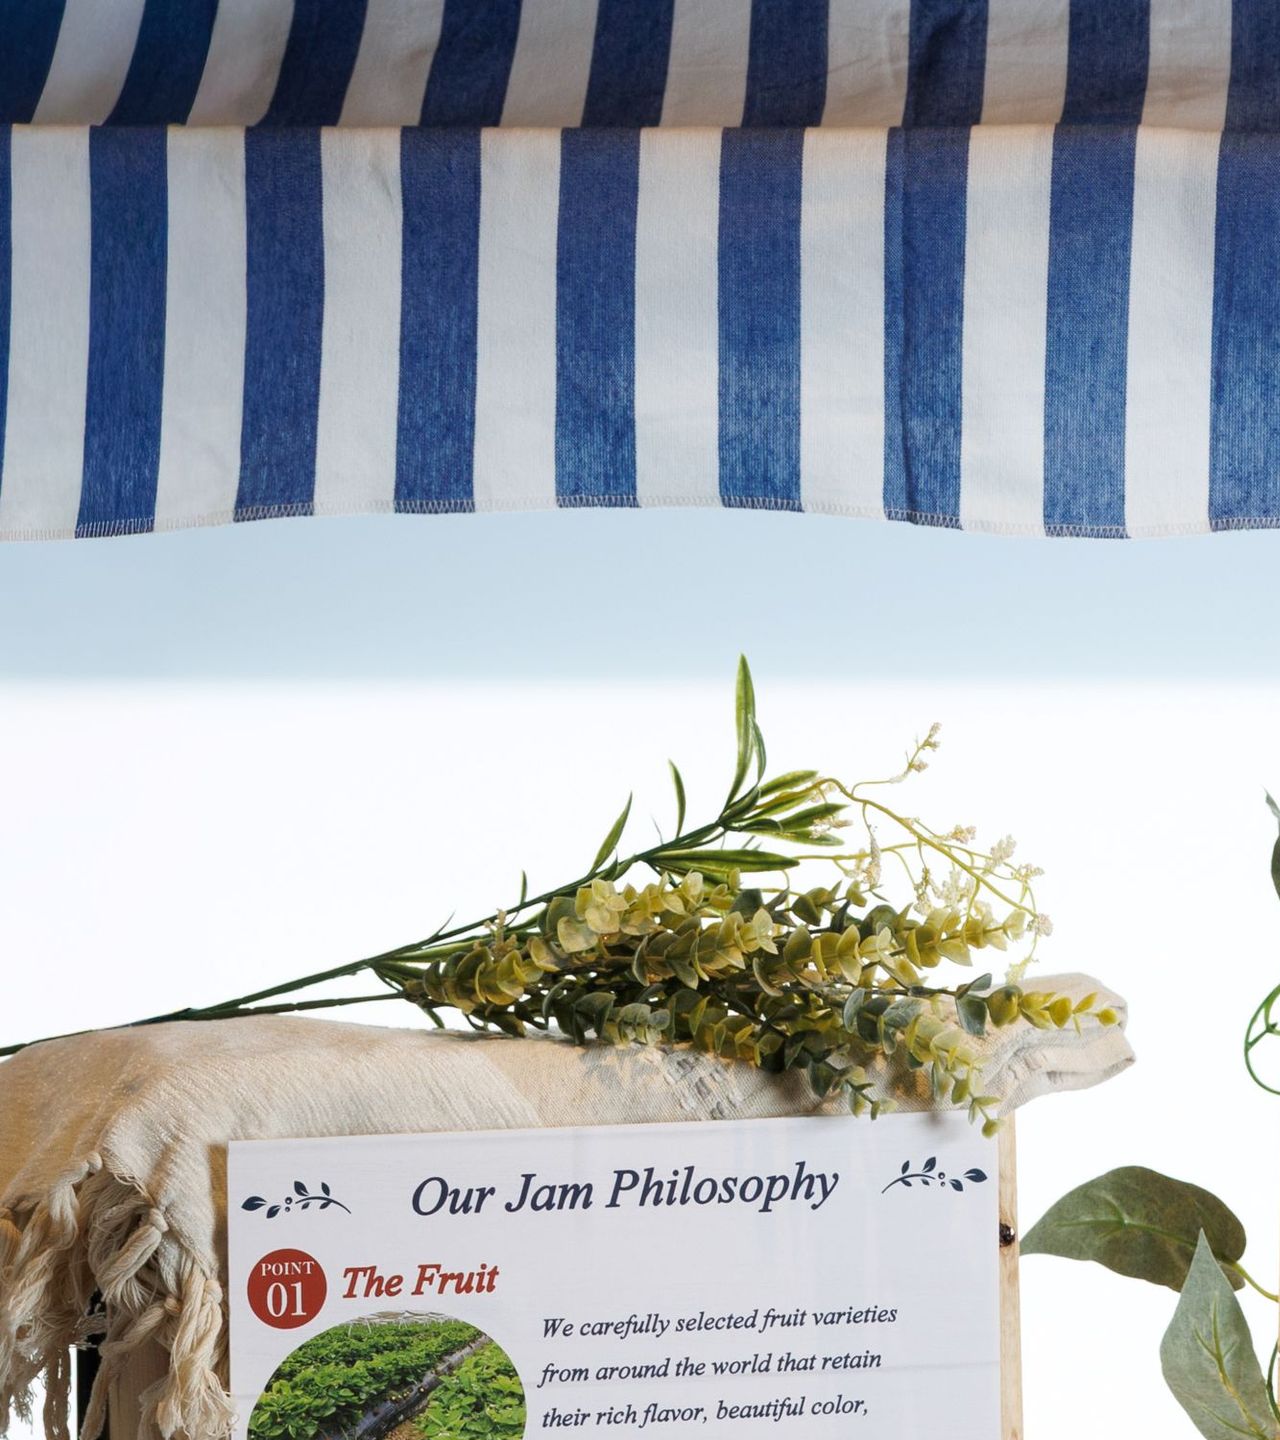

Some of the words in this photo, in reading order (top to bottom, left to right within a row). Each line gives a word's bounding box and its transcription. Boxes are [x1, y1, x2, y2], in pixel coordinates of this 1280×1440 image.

[411, 1176, 497, 1217] Our
[504, 1173, 594, 1213] Jam
[604, 1160, 840, 1213] Philosophy
[262, 1261, 311, 1276] POINT
[342, 1265, 404, 1299] The
[410, 1262, 500, 1296] Fruit
[266, 1281, 307, 1317] 01
[543, 1317, 575, 1339] We
[579, 1312, 671, 1340] carefully
[674, 1308, 760, 1333] selected
[757, 1307, 808, 1334] fruit
[811, 1304, 899, 1326] varieties
[536, 1362, 590, 1389] from
[595, 1357, 672, 1381] around
[674, 1356, 707, 1378] the
[710, 1352, 773, 1376] world
[776, 1351, 818, 1373] that
[821, 1349, 882, 1371] retain
[542, 1407, 592, 1429] their
[595, 1403, 638, 1426] rich
[637, 1402, 708, 1429] flavor,
[715, 1395, 806, 1423] beautiful
[810, 1393, 868, 1417] color,
